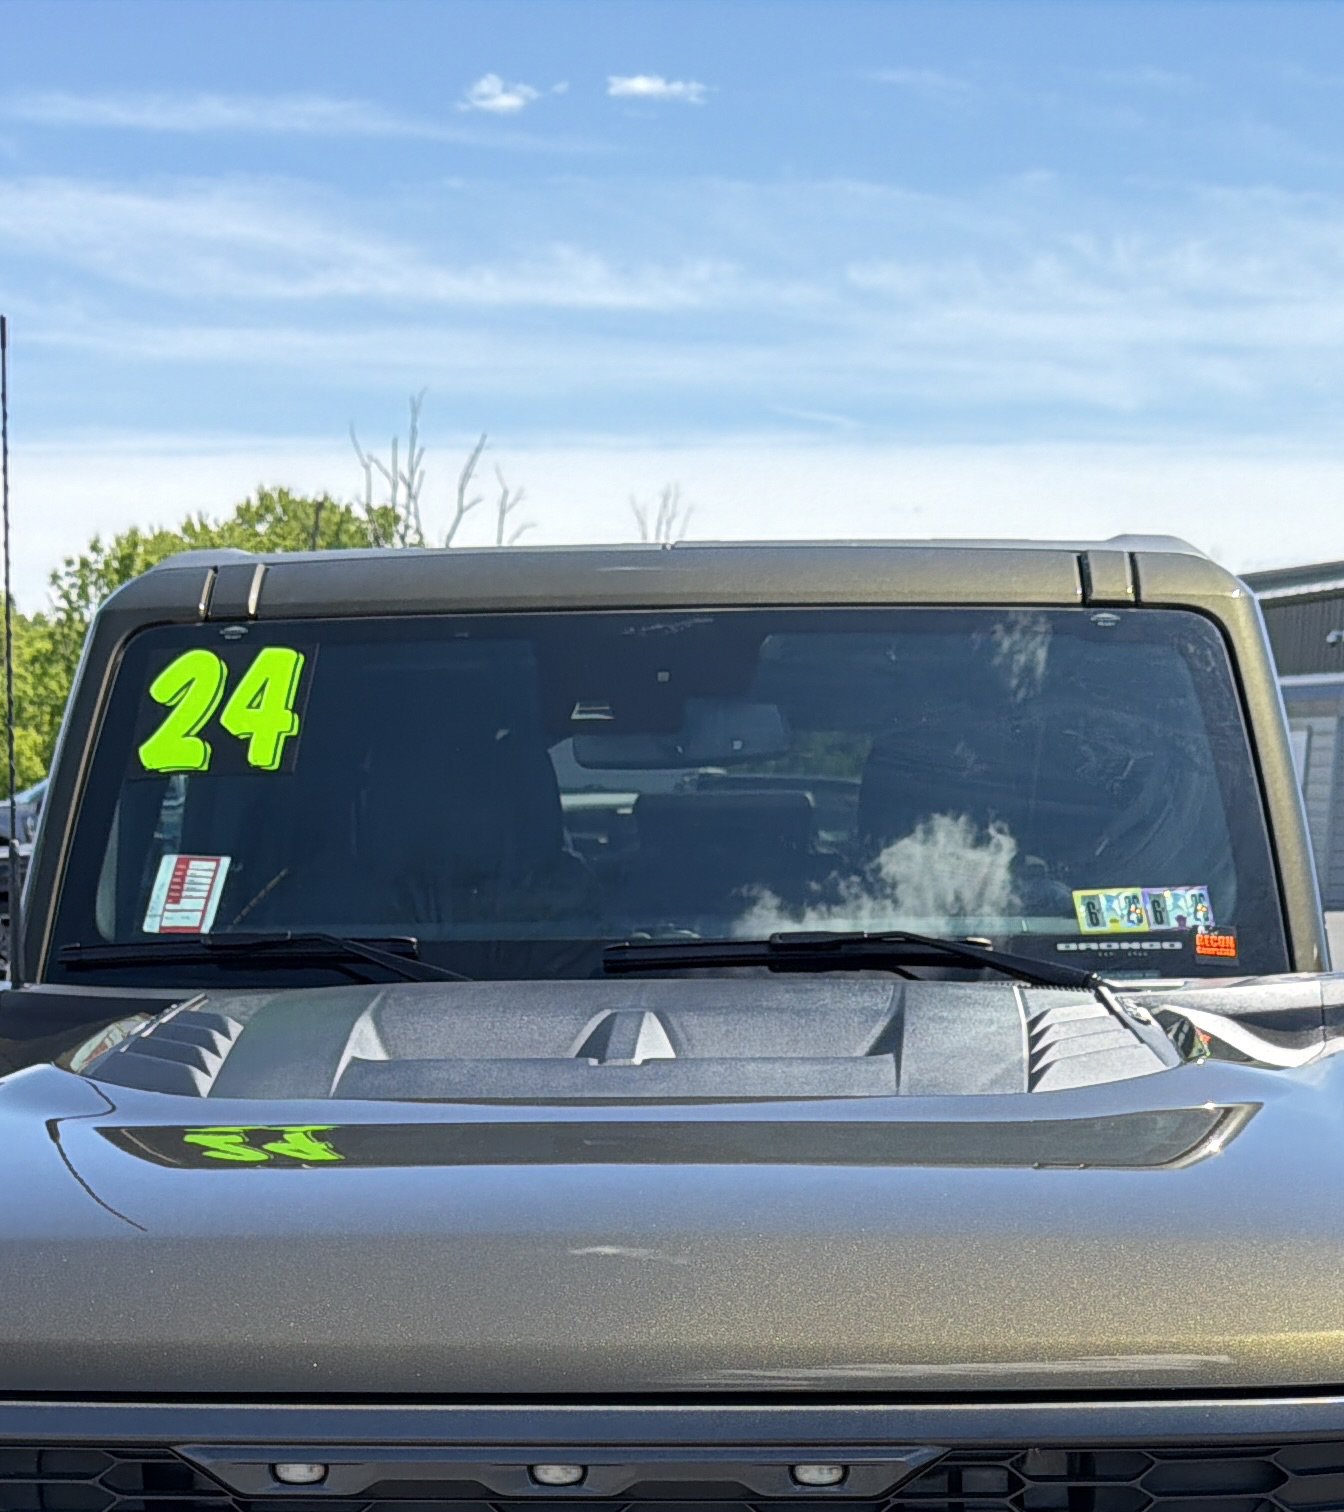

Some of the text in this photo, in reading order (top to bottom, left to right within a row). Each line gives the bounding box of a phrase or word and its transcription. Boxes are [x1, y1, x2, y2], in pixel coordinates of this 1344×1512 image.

[138, 646, 306, 773] 24
[1086, 901, 1100, 927] 6
[1151, 899, 1164, 925] 6
[1057, 942, 1182, 950] BRONCO
